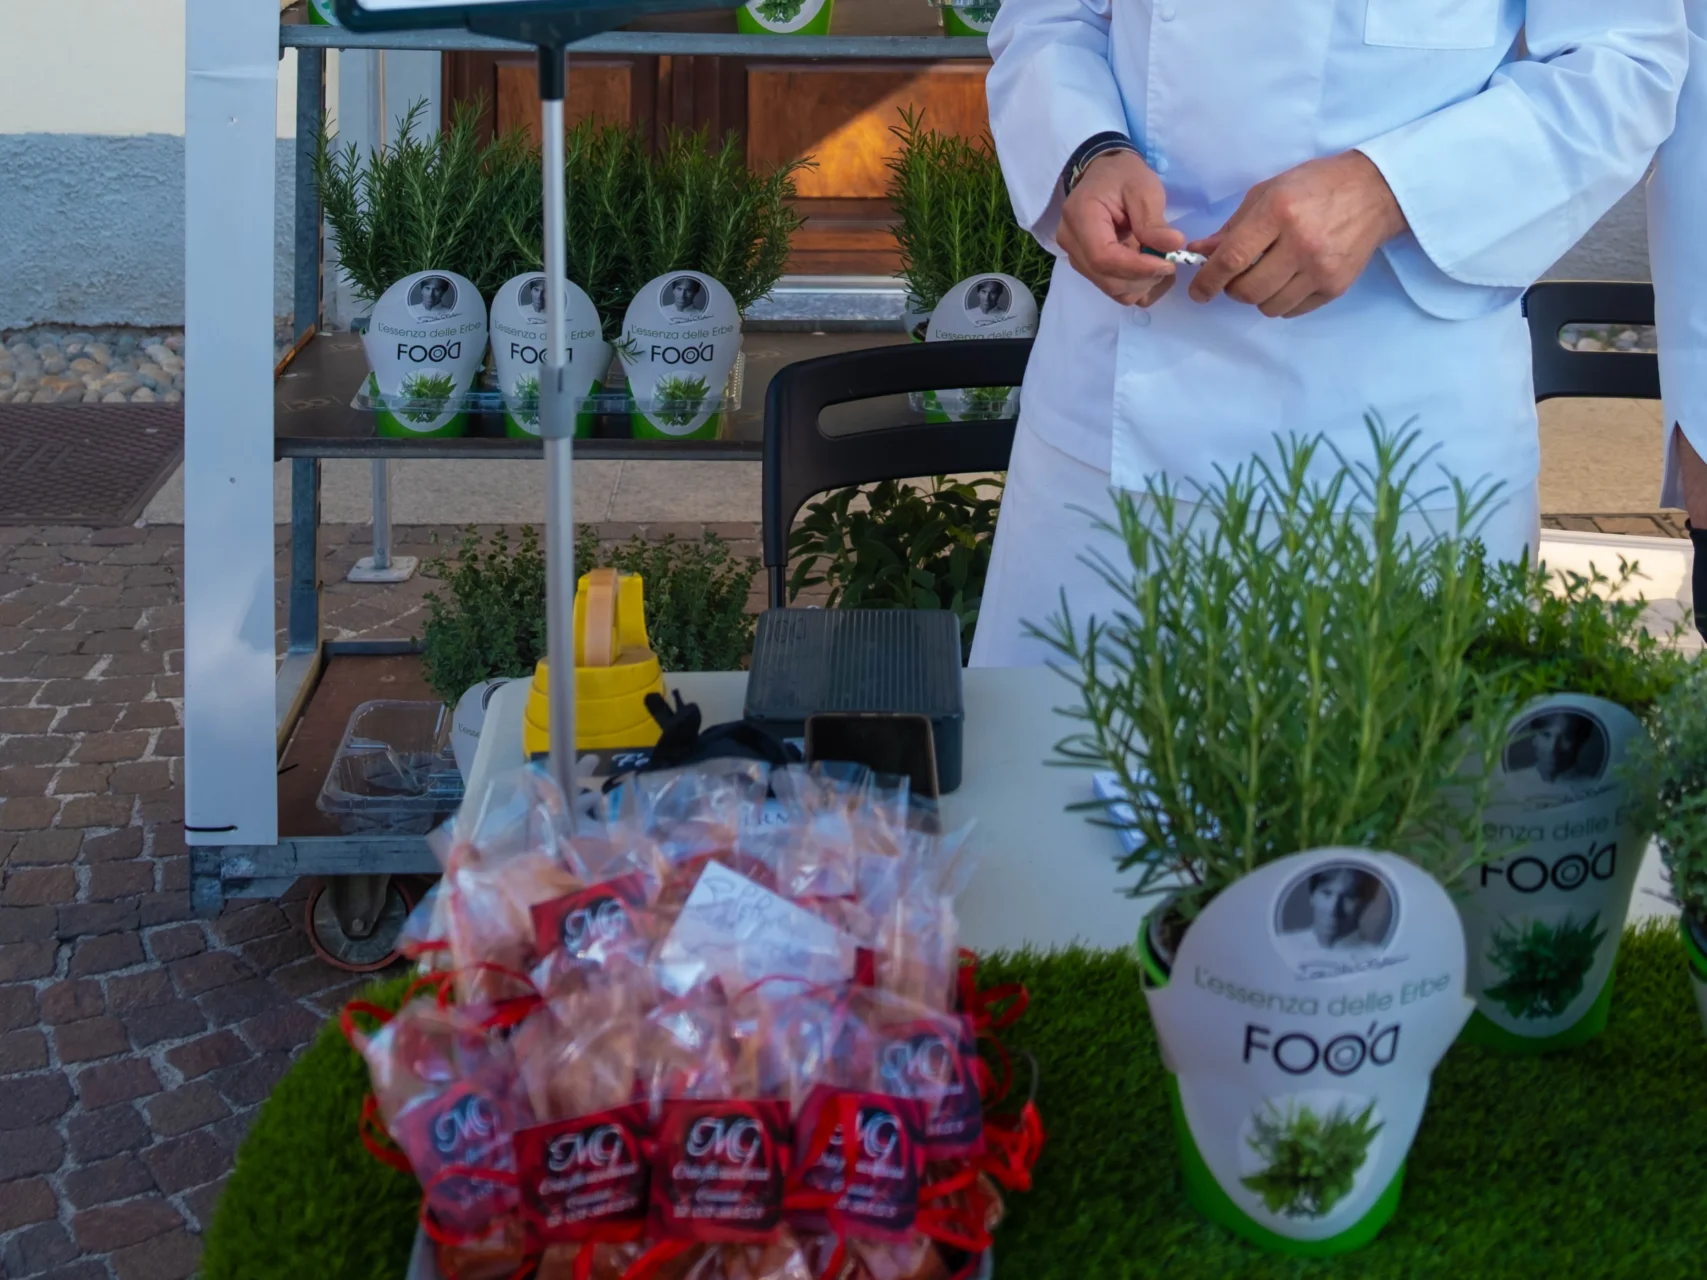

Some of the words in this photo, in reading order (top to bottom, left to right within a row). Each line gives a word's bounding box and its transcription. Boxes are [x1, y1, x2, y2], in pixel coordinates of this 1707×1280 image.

[377, 322, 427, 339] L'essenza
[429, 326, 457, 338] delle
[459, 321, 482, 335] Erbe
[494, 319, 537, 340] L'essenza
[570, 329, 596, 341] Erbe
[630, 324, 680, 340] L'essenza
[681, 329, 710, 340] delle
[711, 324, 735, 337] Erbe
[1193, 964, 1320, 1017] L'essenza
[1326, 991, 1394, 1018] delle
[1399, 972, 1452, 1006] Erbe
